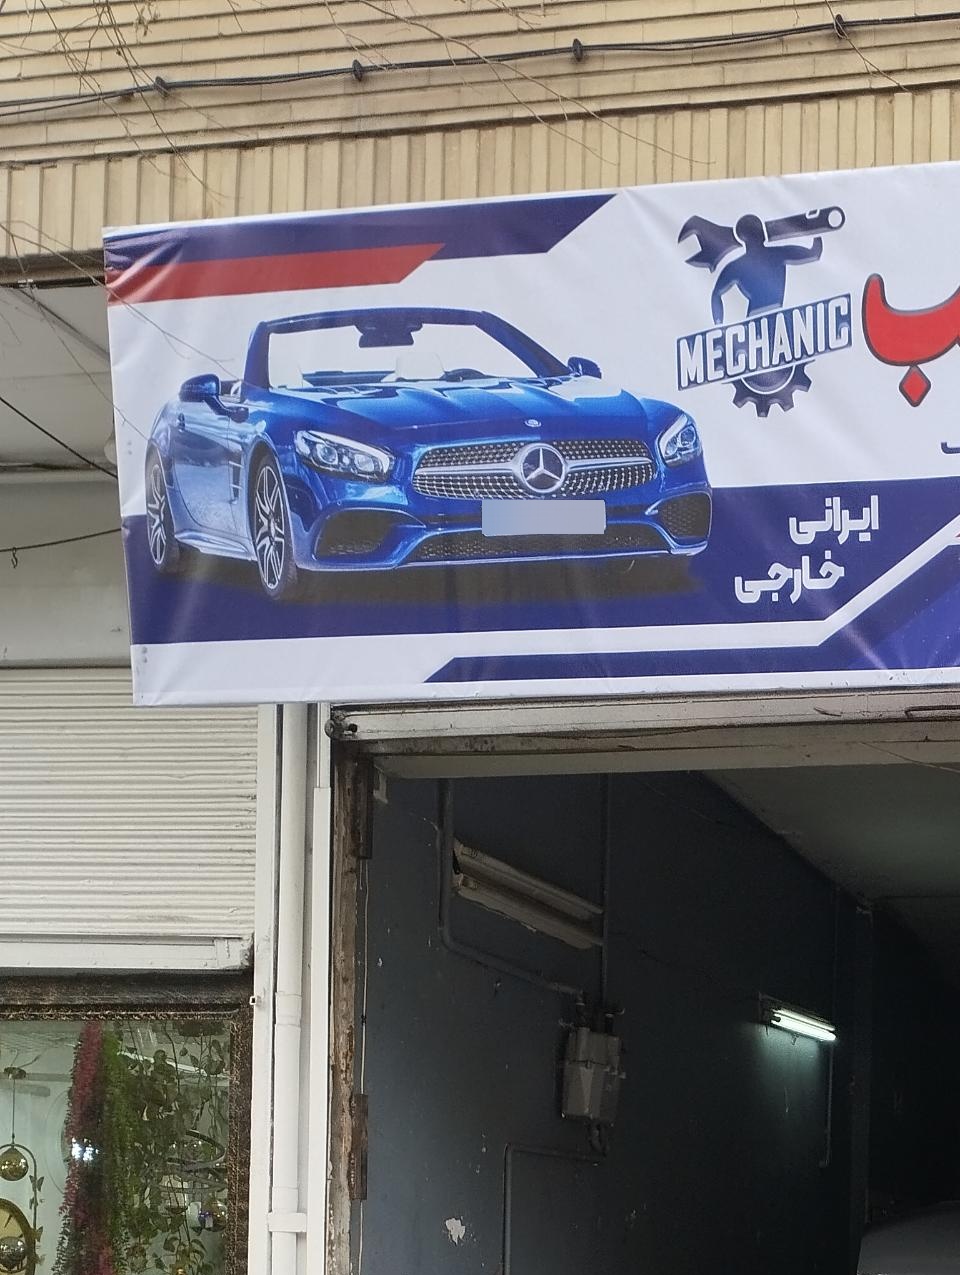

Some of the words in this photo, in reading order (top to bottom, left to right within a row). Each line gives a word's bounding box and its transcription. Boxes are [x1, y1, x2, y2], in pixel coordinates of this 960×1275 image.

[679, 297, 850, 390] MECHANIC
[789, 495, 879, 545] ایرانی
[734, 550, 845, 604] خارجی
